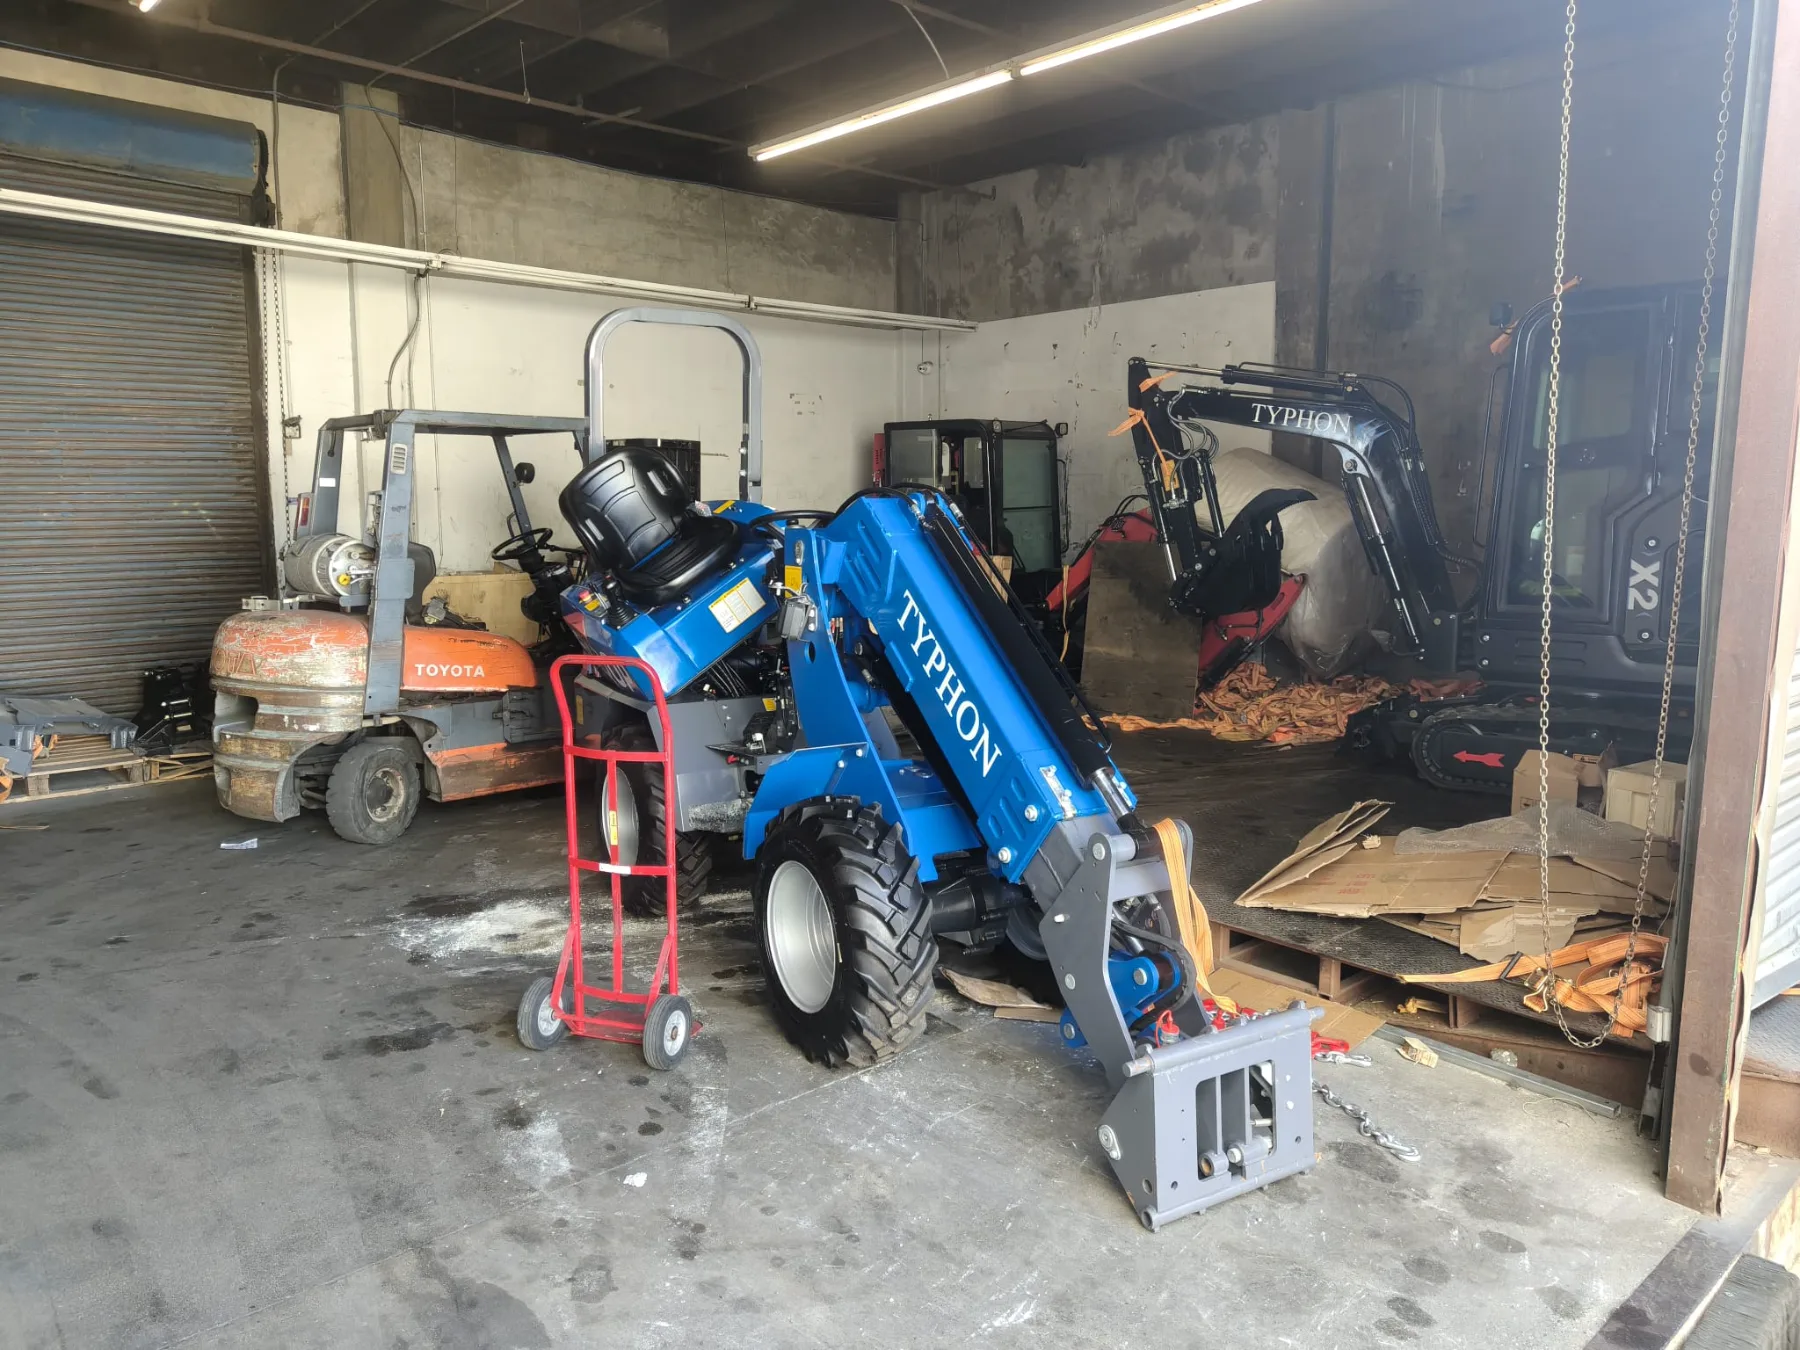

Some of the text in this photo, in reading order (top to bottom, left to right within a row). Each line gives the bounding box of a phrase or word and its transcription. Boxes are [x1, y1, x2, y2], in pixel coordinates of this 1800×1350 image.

[1251, 403, 1353, 434] TYPHON
[1627, 559, 1660, 611] X2
[414, 663, 485, 677] TOYOTA
[897, 589, 1002, 778] TYPHON
